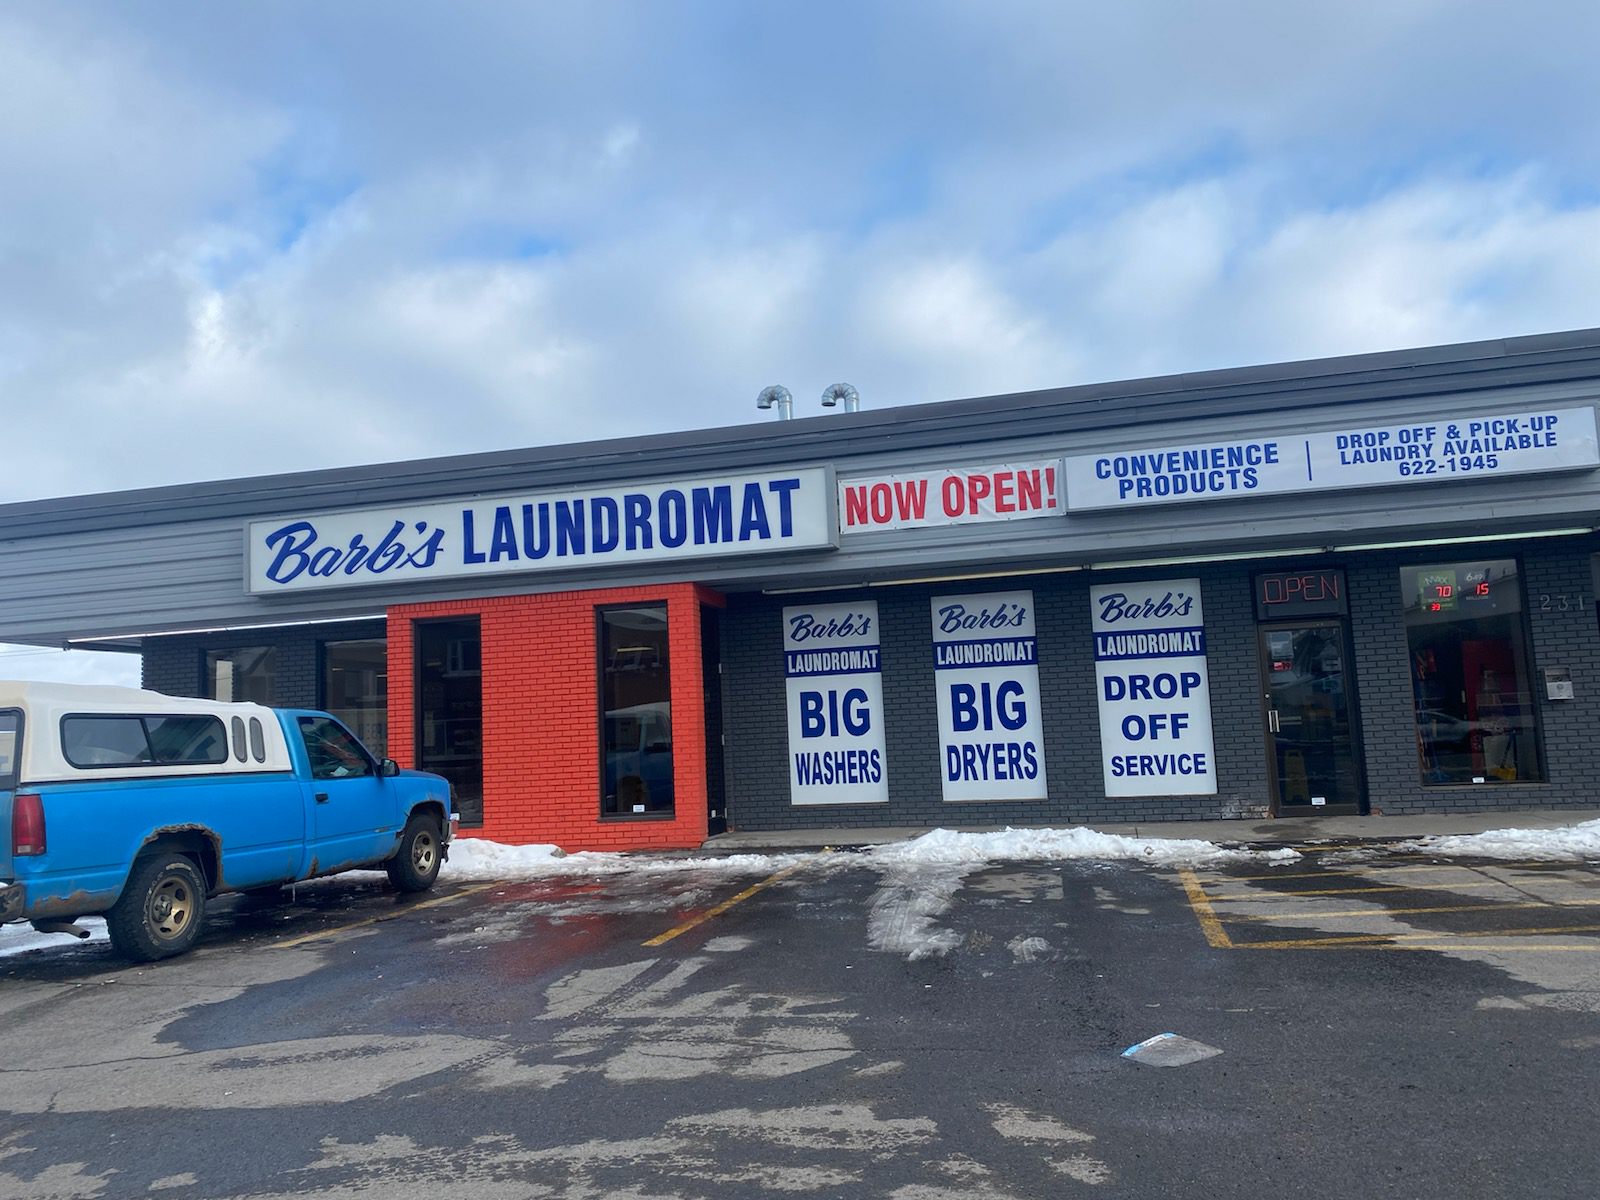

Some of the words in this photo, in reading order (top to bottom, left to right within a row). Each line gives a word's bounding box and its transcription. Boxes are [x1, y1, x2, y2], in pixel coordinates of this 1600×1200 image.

[1336, 431, 1390, 450] DROP
[1398, 427, 1437, 444] OFF
[1446, 424, 1461, 440] &
[1469, 415, 1559, 438] PICK-UP
[1095, 442, 1279, 481] CONVENIENCE
[1340, 443, 1433, 465] LAUNDRY
[1443, 432, 1558, 456] AVAILABLE
[1399, 454, 1498, 476] 622-1945
[845, 480, 928, 526] NOW
[941, 468, 1057, 518] OPEN!
[1118, 471, 1259, 500] PRODUCTS
[265, 520, 445, 585] Barb's
[462, 478, 801, 565] LAUNDROMAT
[1262, 575, 1338, 604] OPEN
[1435, 585, 1453, 598] 70
[1476, 583, 1489, 596] 15
[1540, 594, 1585, 611] 231
[939, 603, 1027, 634] Barb's
[1099, 592, 1194, 624] Barb's
[790, 613, 872, 642] Barb's
[936, 640, 1035, 666] LAUNDROMAT
[1098, 630, 1202, 657] LAUNDROMAT
[787, 649, 879, 673] LAUNDROMAT
[1104, 671, 1202, 702] DROP
[800, 688, 871, 739] BIG
[951, 681, 1028, 732] BIG
[1122, 712, 1189, 741] OFF
[795, 748, 882, 785] WASHERS
[947, 741, 1039, 782] DRYERS
[1111, 753, 1207, 777] SERVICE
